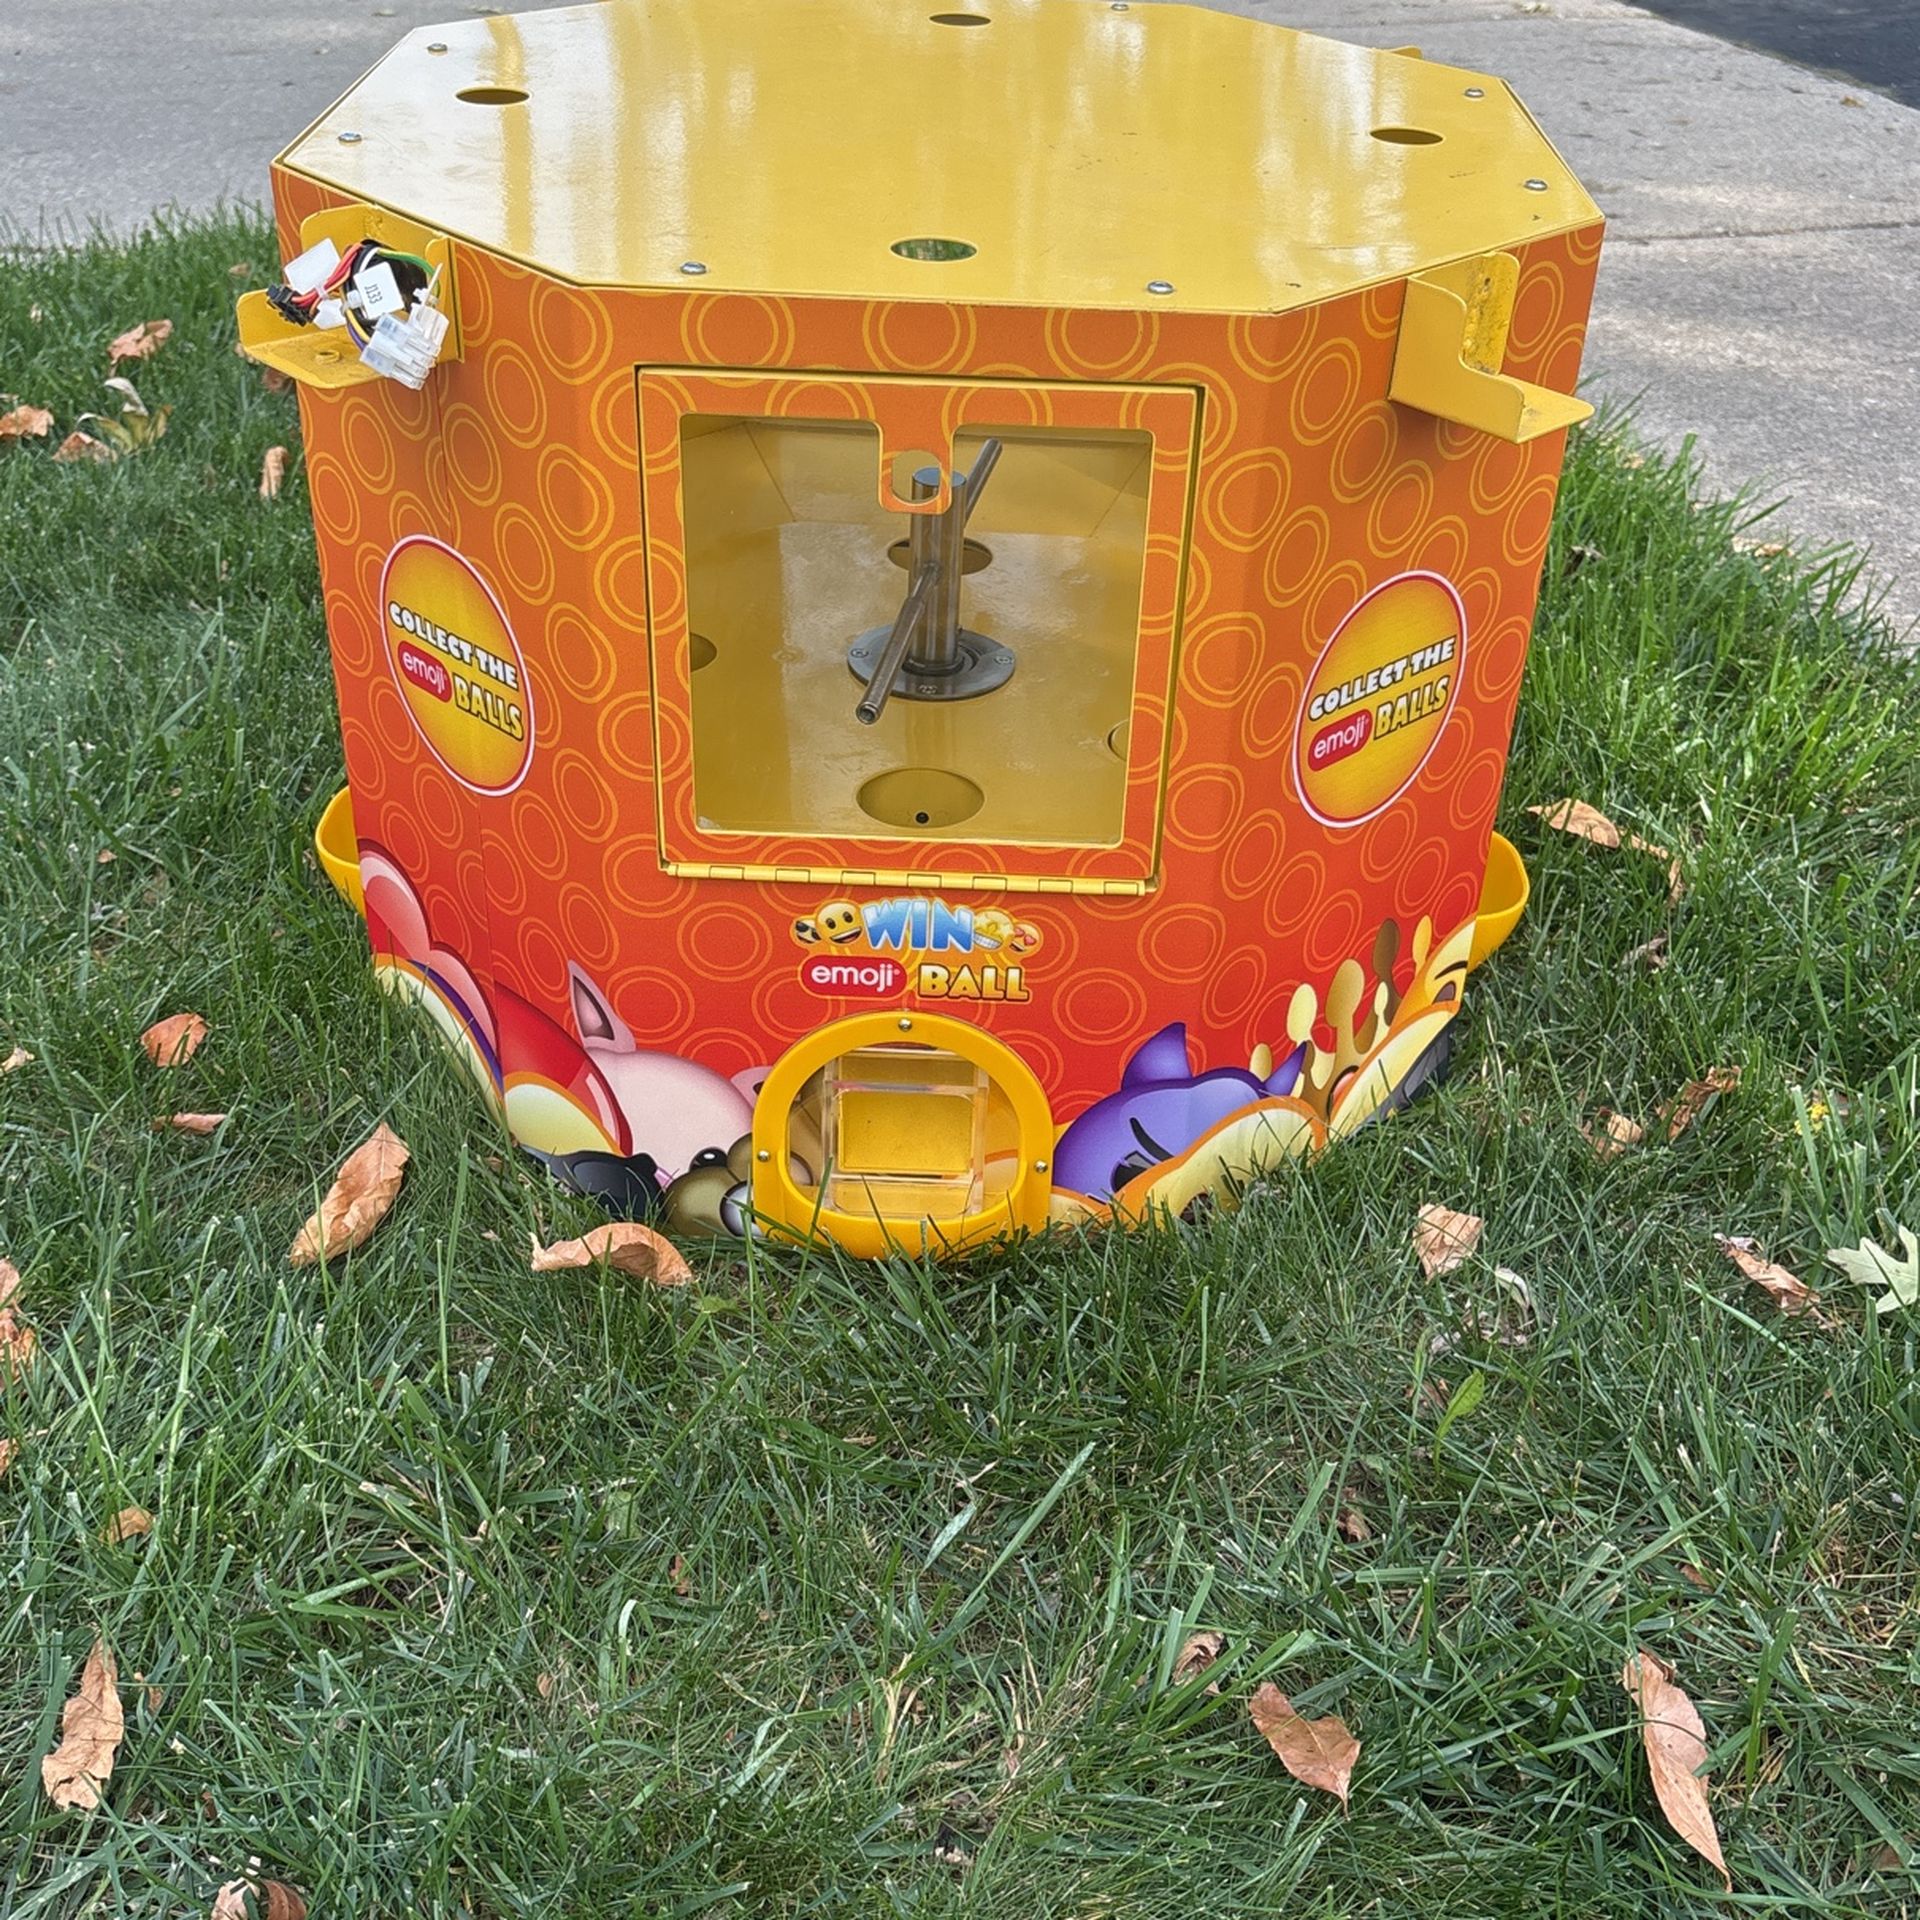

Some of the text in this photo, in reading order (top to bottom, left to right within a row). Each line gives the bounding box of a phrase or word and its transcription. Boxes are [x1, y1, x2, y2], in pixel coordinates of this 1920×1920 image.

[389, 601, 518, 691] COLLECT THE
[1309, 635, 1457, 721] COLLECT THE
[403, 651, 524, 741] emoji BALLS
[1314, 675, 1451, 759] emoji BALLS
[862, 898, 975, 953] WIN
[811, 962, 1031, 1001] emoji BALL
